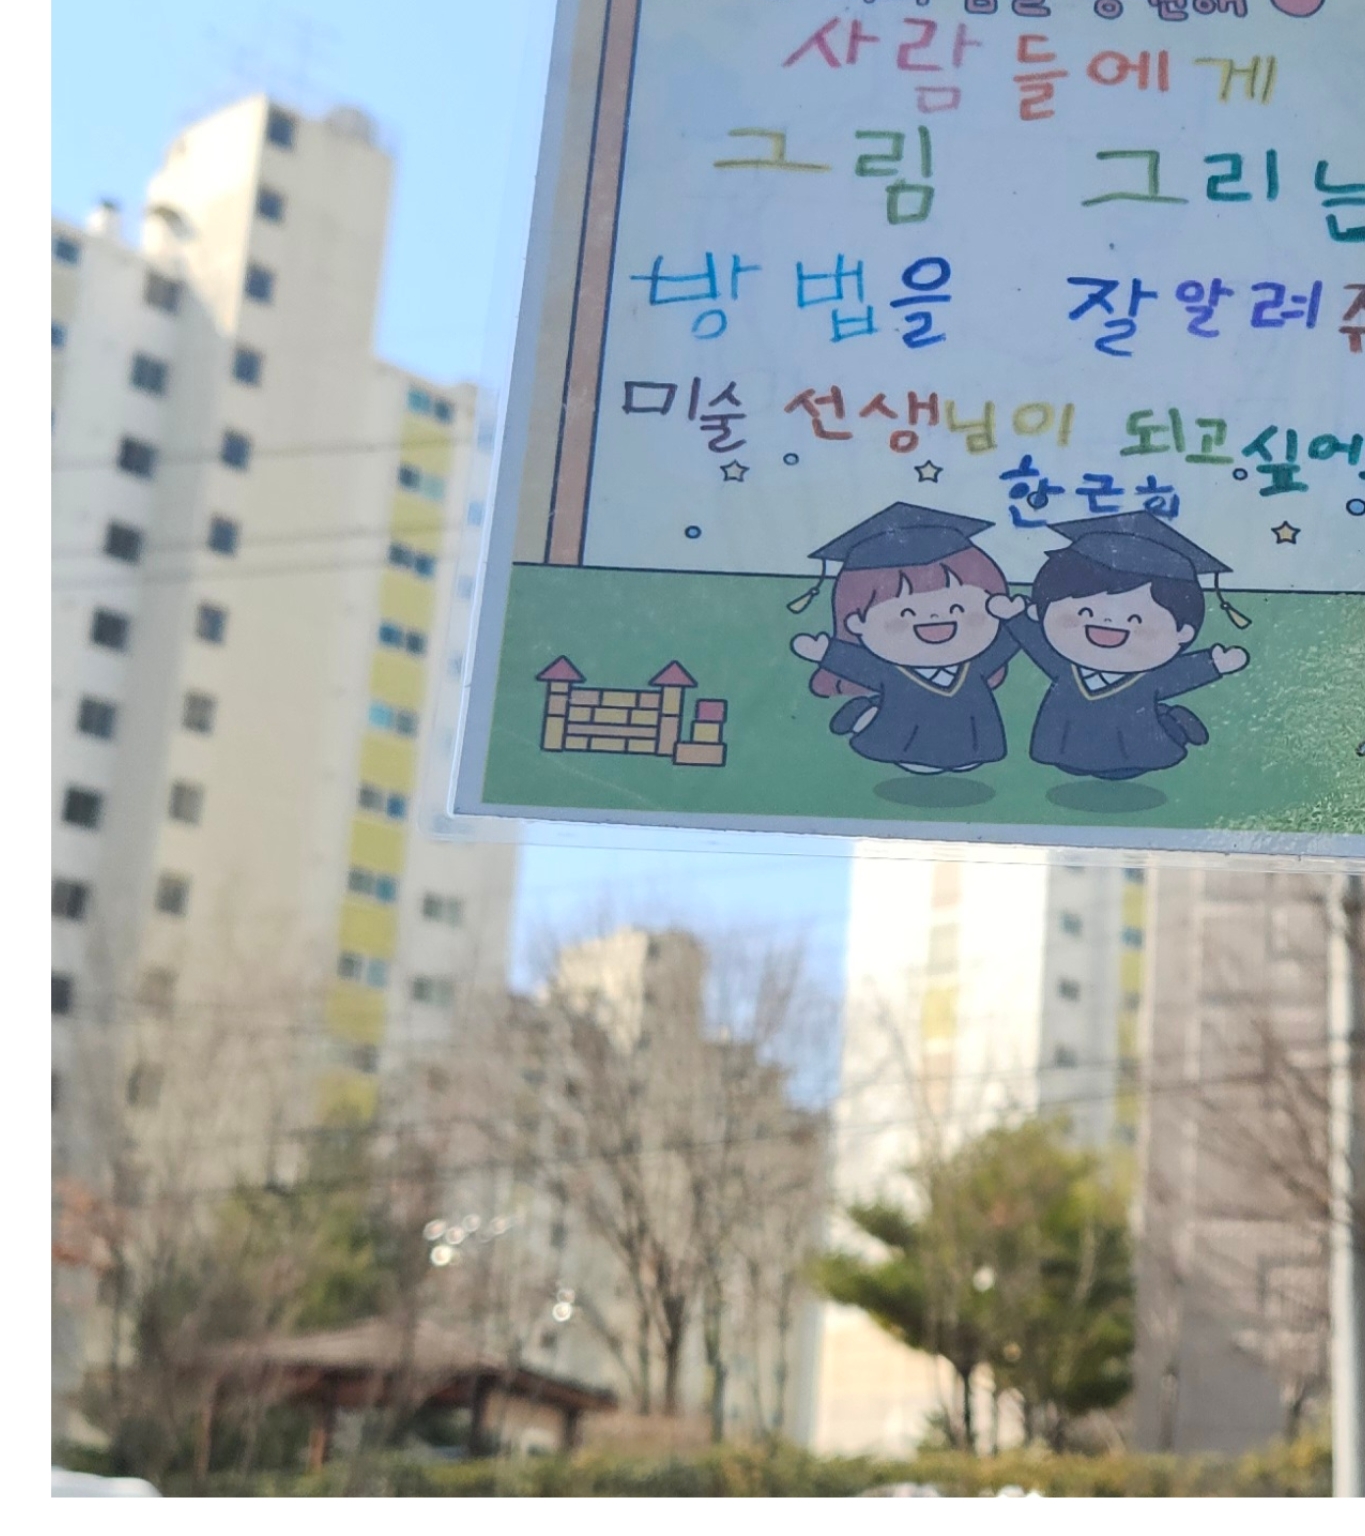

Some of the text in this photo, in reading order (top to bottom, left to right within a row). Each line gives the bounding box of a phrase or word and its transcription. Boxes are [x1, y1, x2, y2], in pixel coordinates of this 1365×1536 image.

[783, 16, 1278, 121] 사람들에게
[714, 125, 935, 224] 그림
[630, 252, 953, 349] 방법을
[621, 376, 747, 454] 미술
[784, 384, 1076, 455] 선생님이
